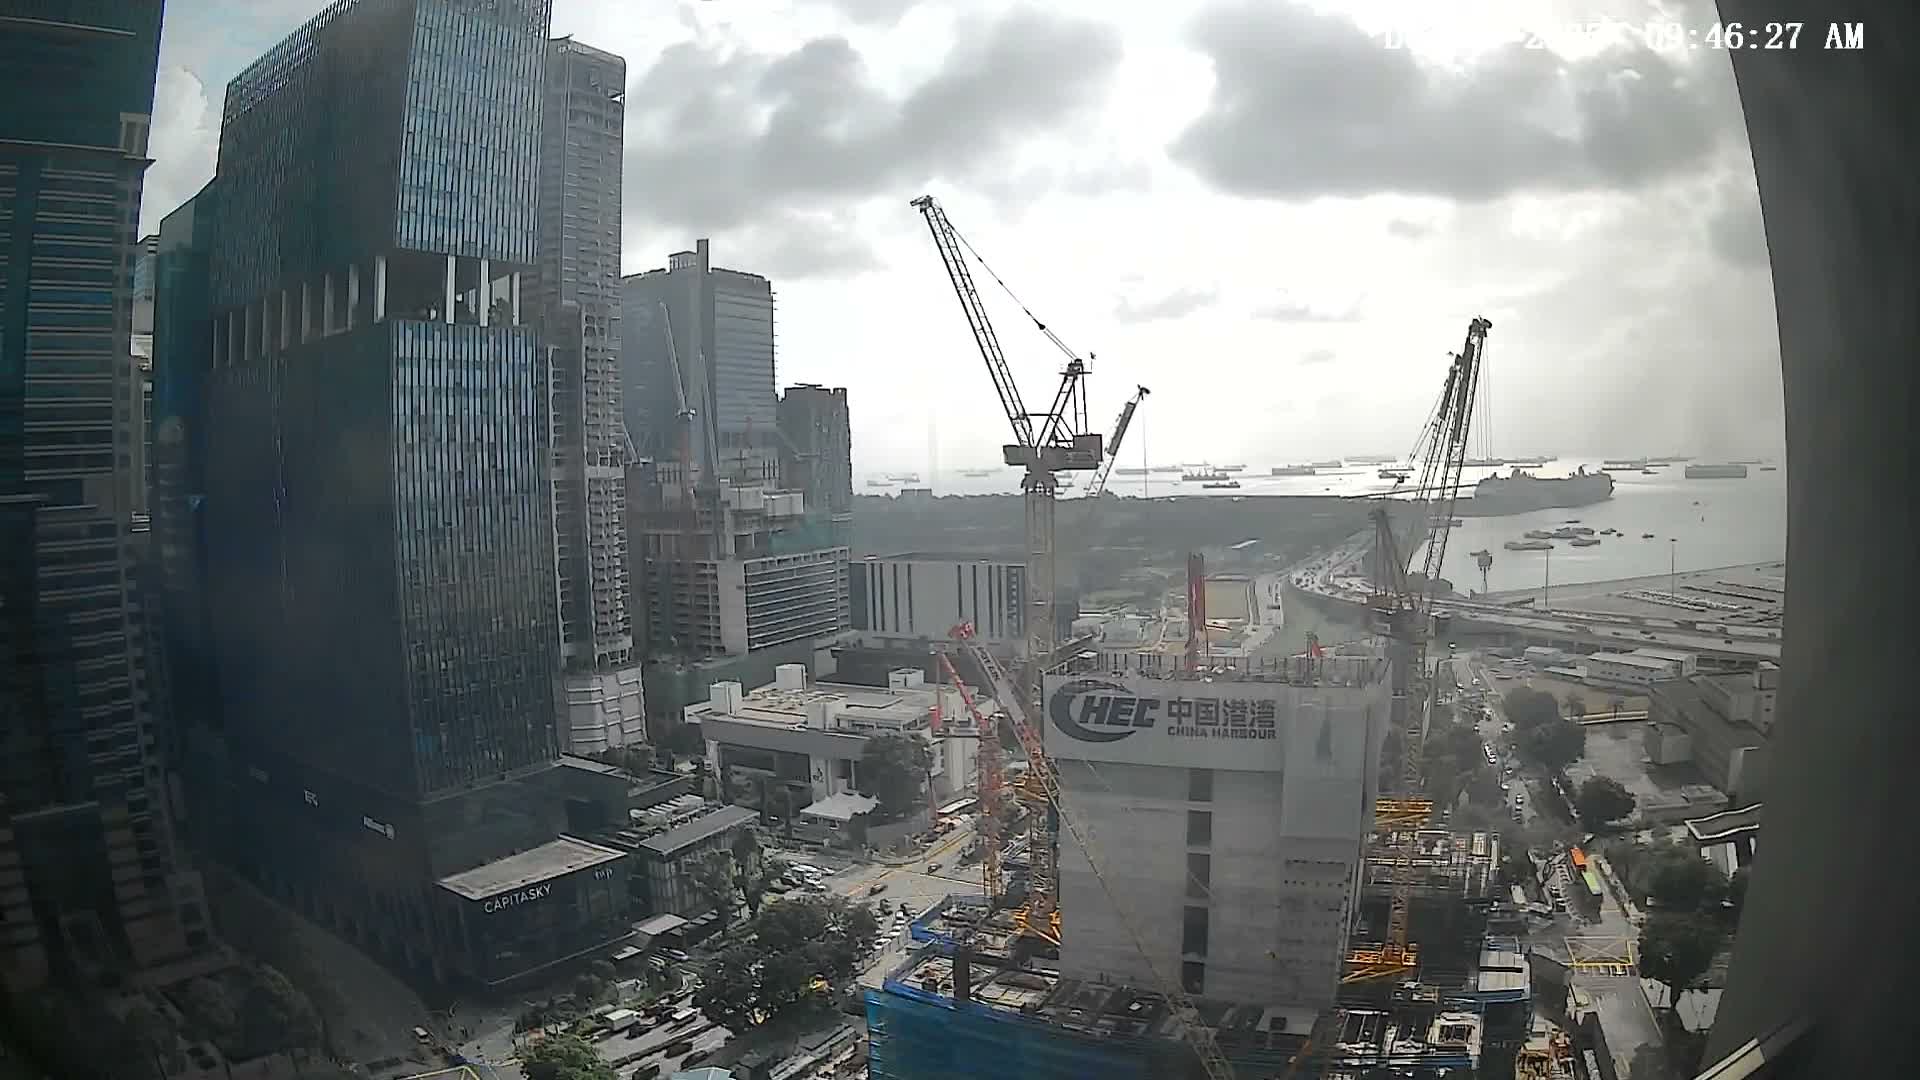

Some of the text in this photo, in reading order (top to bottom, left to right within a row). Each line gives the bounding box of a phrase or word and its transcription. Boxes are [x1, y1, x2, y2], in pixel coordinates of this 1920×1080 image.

[1167, 696, 1277, 728] 中国港湾
[1167, 727, 1277, 740] CHINA HARBOUR
[484, 884, 552, 913] CAPITASKY
